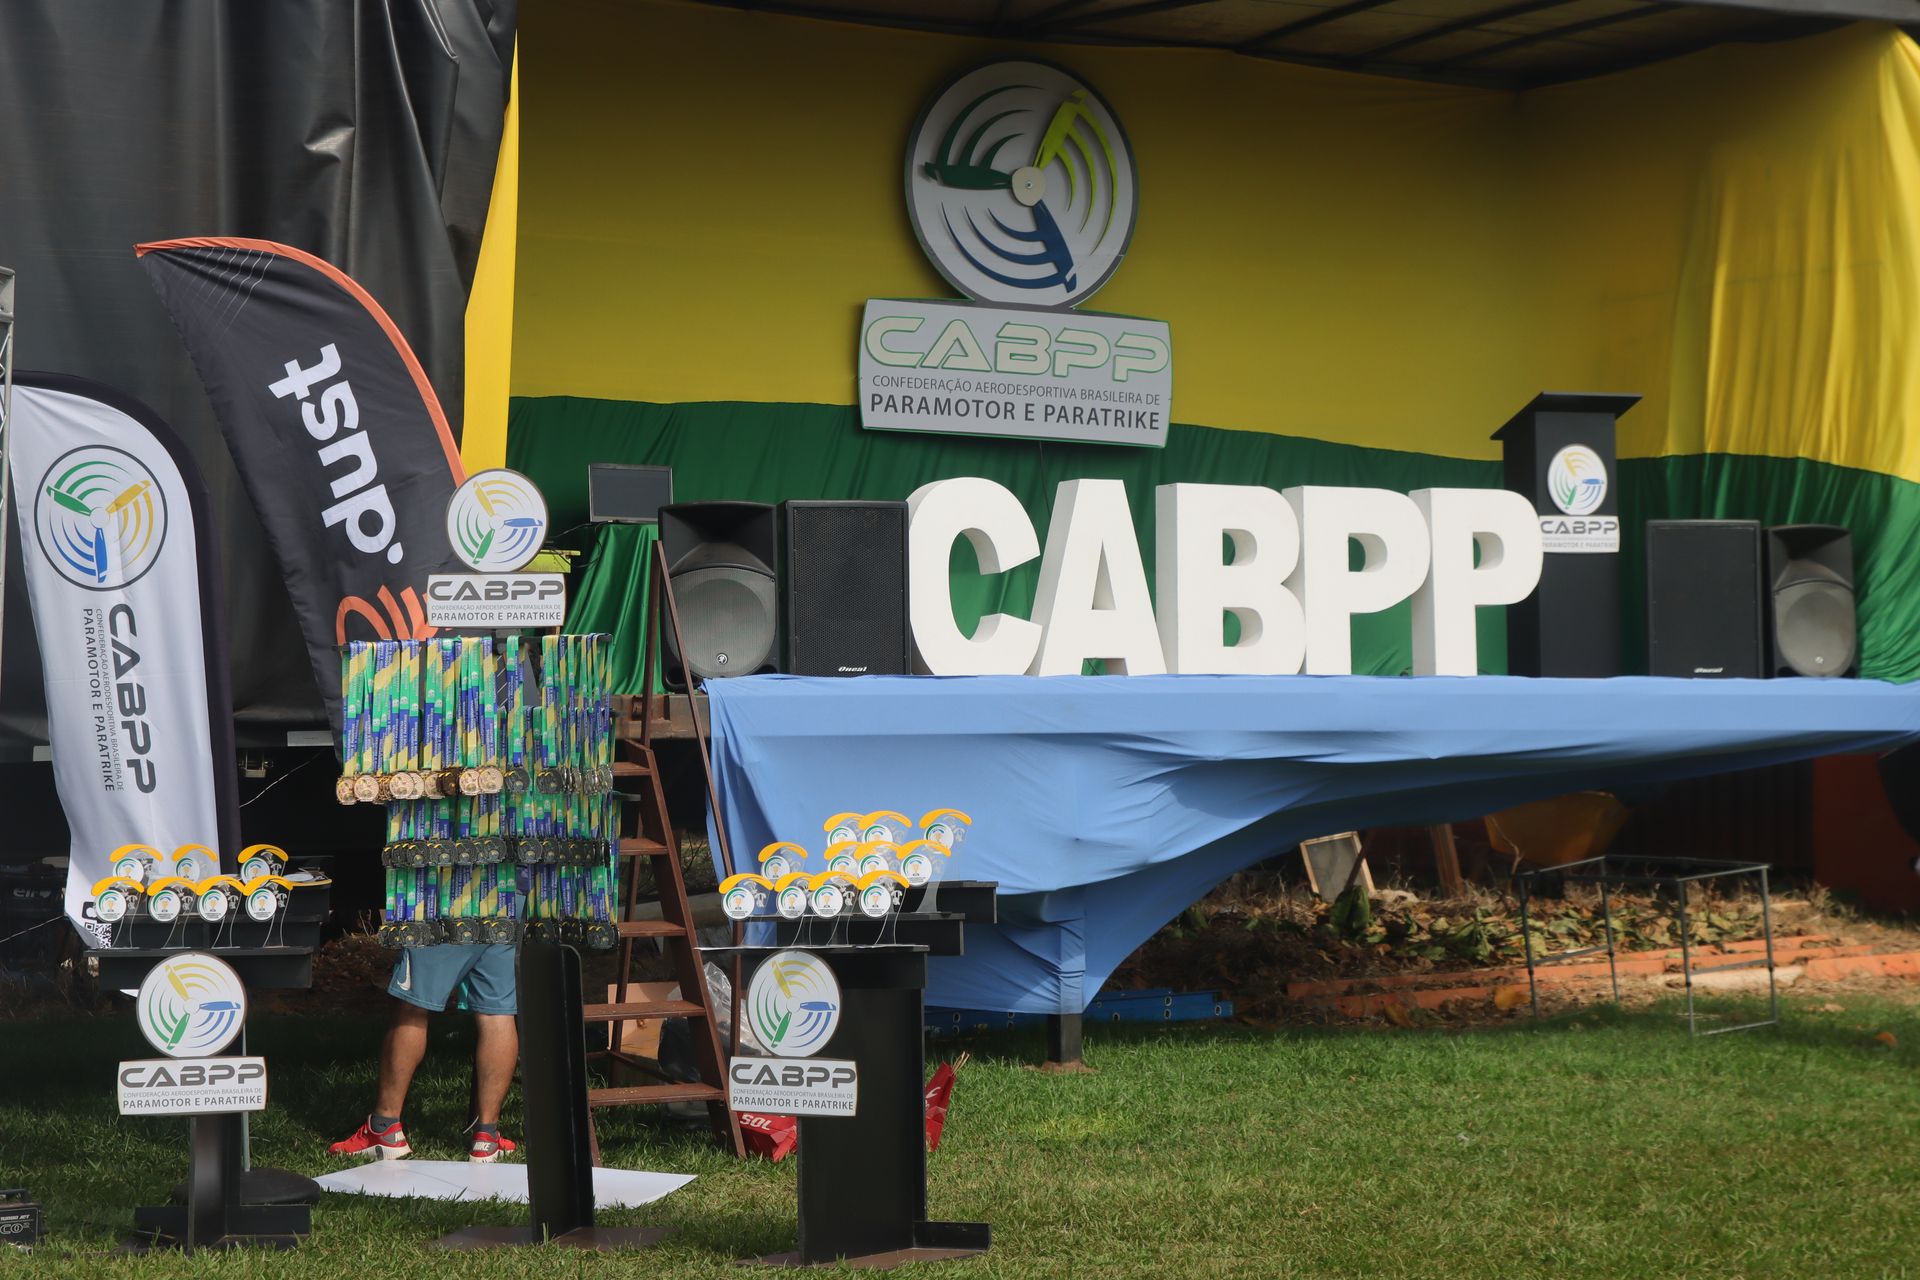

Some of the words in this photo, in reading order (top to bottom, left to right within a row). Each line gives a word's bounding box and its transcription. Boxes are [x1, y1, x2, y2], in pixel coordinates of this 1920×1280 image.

[866, 316, 1169, 382] CABPP
[872, 375, 972, 393] CONFEDERAÇÃO
[975, 382, 1077, 399] AERODESPORTIVA
[1081, 389, 1142, 404] BRASILEIRA
[1146, 394, 1160, 405] DE
[871, 393, 1015, 420] PARAMOTOR
[1024, 403, 1035, 421] E
[1044, 404, 1159, 430] PARATRIKE
[1540, 521, 1618, 534] CABPP
[906, 477, 1544, 675] CABPP
[429, 581, 563, 600] CABPP
[431, 612, 494, 620] PARAMOTOR
[498, 612, 503, 620] E
[507, 612, 560, 620] PARATRIKE
[83, 608, 101, 698] PARAMOTOR
[94, 716, 115, 791] PARATRIKE
[96, 608, 108, 670] CONFEDERAÇÃO
[111, 738, 122, 780] BRASILEIRA
[117, 781, 124, 791] DE
[109, 603, 156, 793] CABPP
[120, 1063, 264, 1088] CABPP
[731, 1064, 856, 1088] CABPP
[123, 1098, 191, 1108] PARAMOTOR
[195, 1097, 200, 1106] E
[204, 1095, 262, 1106] PARATRIKE
[733, 1096, 791, 1107] PARAMOTOR
[794, 1099, 799, 1107] E
[802, 1099, 853, 1110] PARATRIKE
[740, 1114, 772, 1130] SOL
